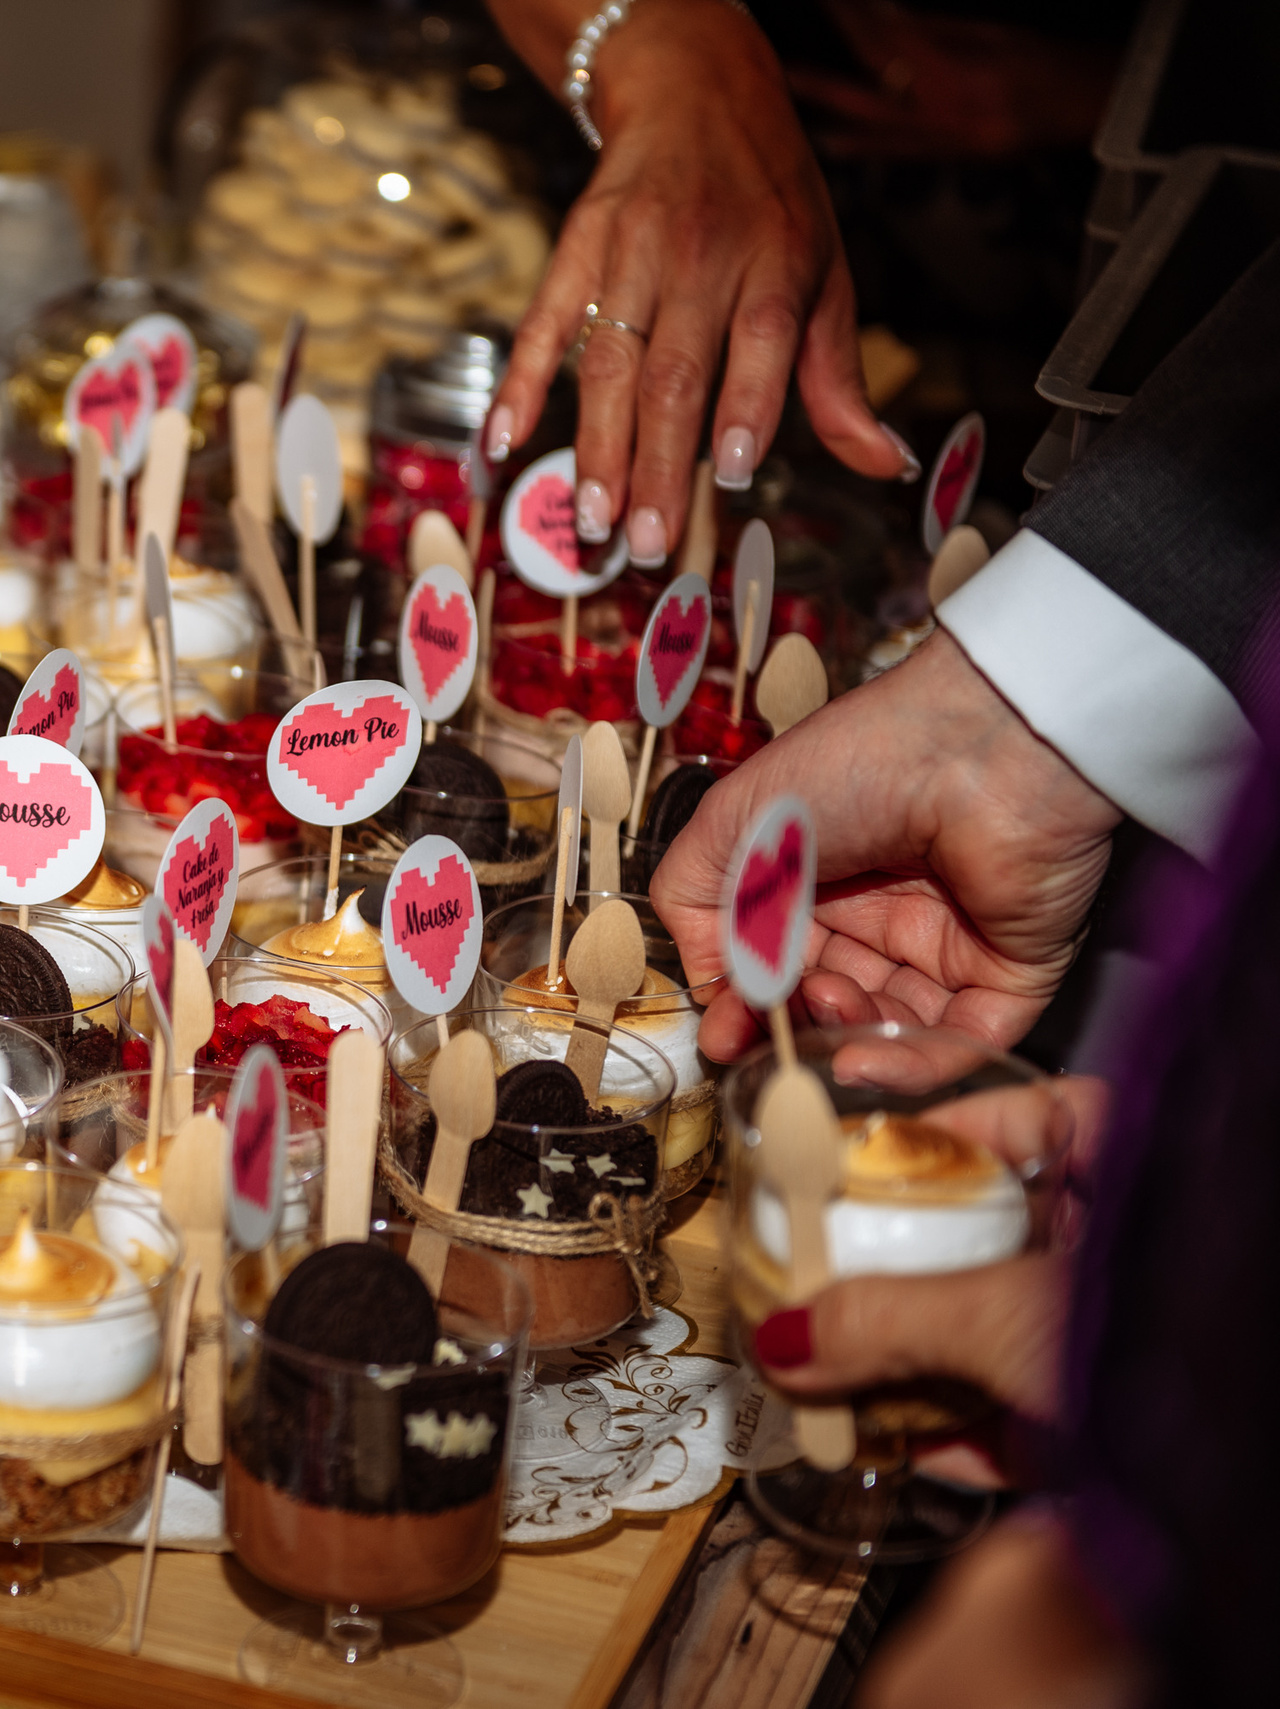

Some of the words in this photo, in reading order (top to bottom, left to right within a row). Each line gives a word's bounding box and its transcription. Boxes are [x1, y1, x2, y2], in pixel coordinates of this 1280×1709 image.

[57, 690, 76, 719] Pie
[286, 728, 360, 756] Lemon
[363, 717, 400, 743] Pie
[183, 852, 207, 883] Cake
[208, 842, 219, 866] de
[175, 869, 217, 913] Naranja
[402, 898, 463, 941] Mousse
